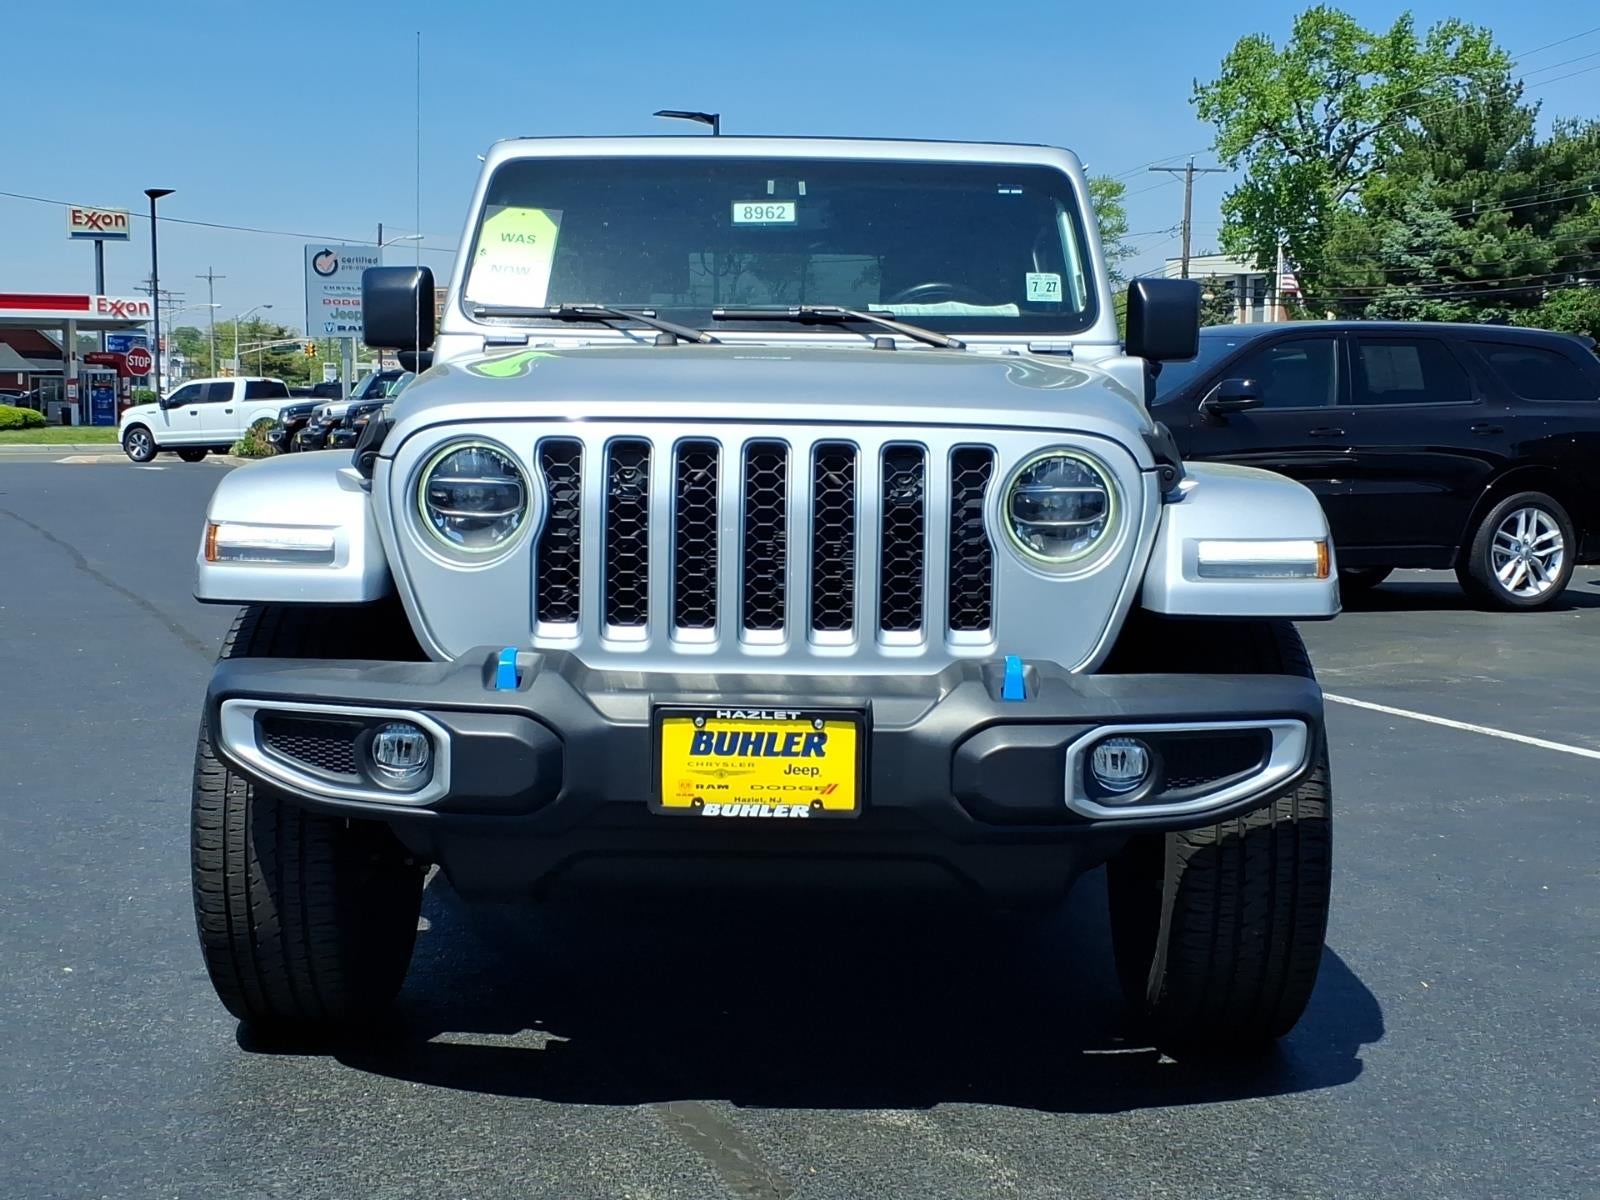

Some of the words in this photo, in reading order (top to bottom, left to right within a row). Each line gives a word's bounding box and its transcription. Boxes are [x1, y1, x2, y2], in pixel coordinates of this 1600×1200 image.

[71, 209, 127, 231] Exxon
[743, 206, 786, 220] 8962
[500, 232, 537, 246] WAS
[341, 256, 378, 264] certified
[490, 264, 532, 275] NOW
[1032, 281, 1038, 292] 7
[1046, 281, 1057, 292] 27
[97, 298, 150, 318] Exxon
[322, 298, 361, 306] DODG
[330, 307, 362, 322] Jeep
[128, 354, 151, 368] STOP
[716, 709, 802, 720] HAZLET
[689, 730, 828, 758] BUHLER
[783, 763, 820, 778] Jeep
[734, 796, 767, 804] Hazlet,
[769, 796, 782, 804] NJ
[701, 803, 811, 818] BUHLER
